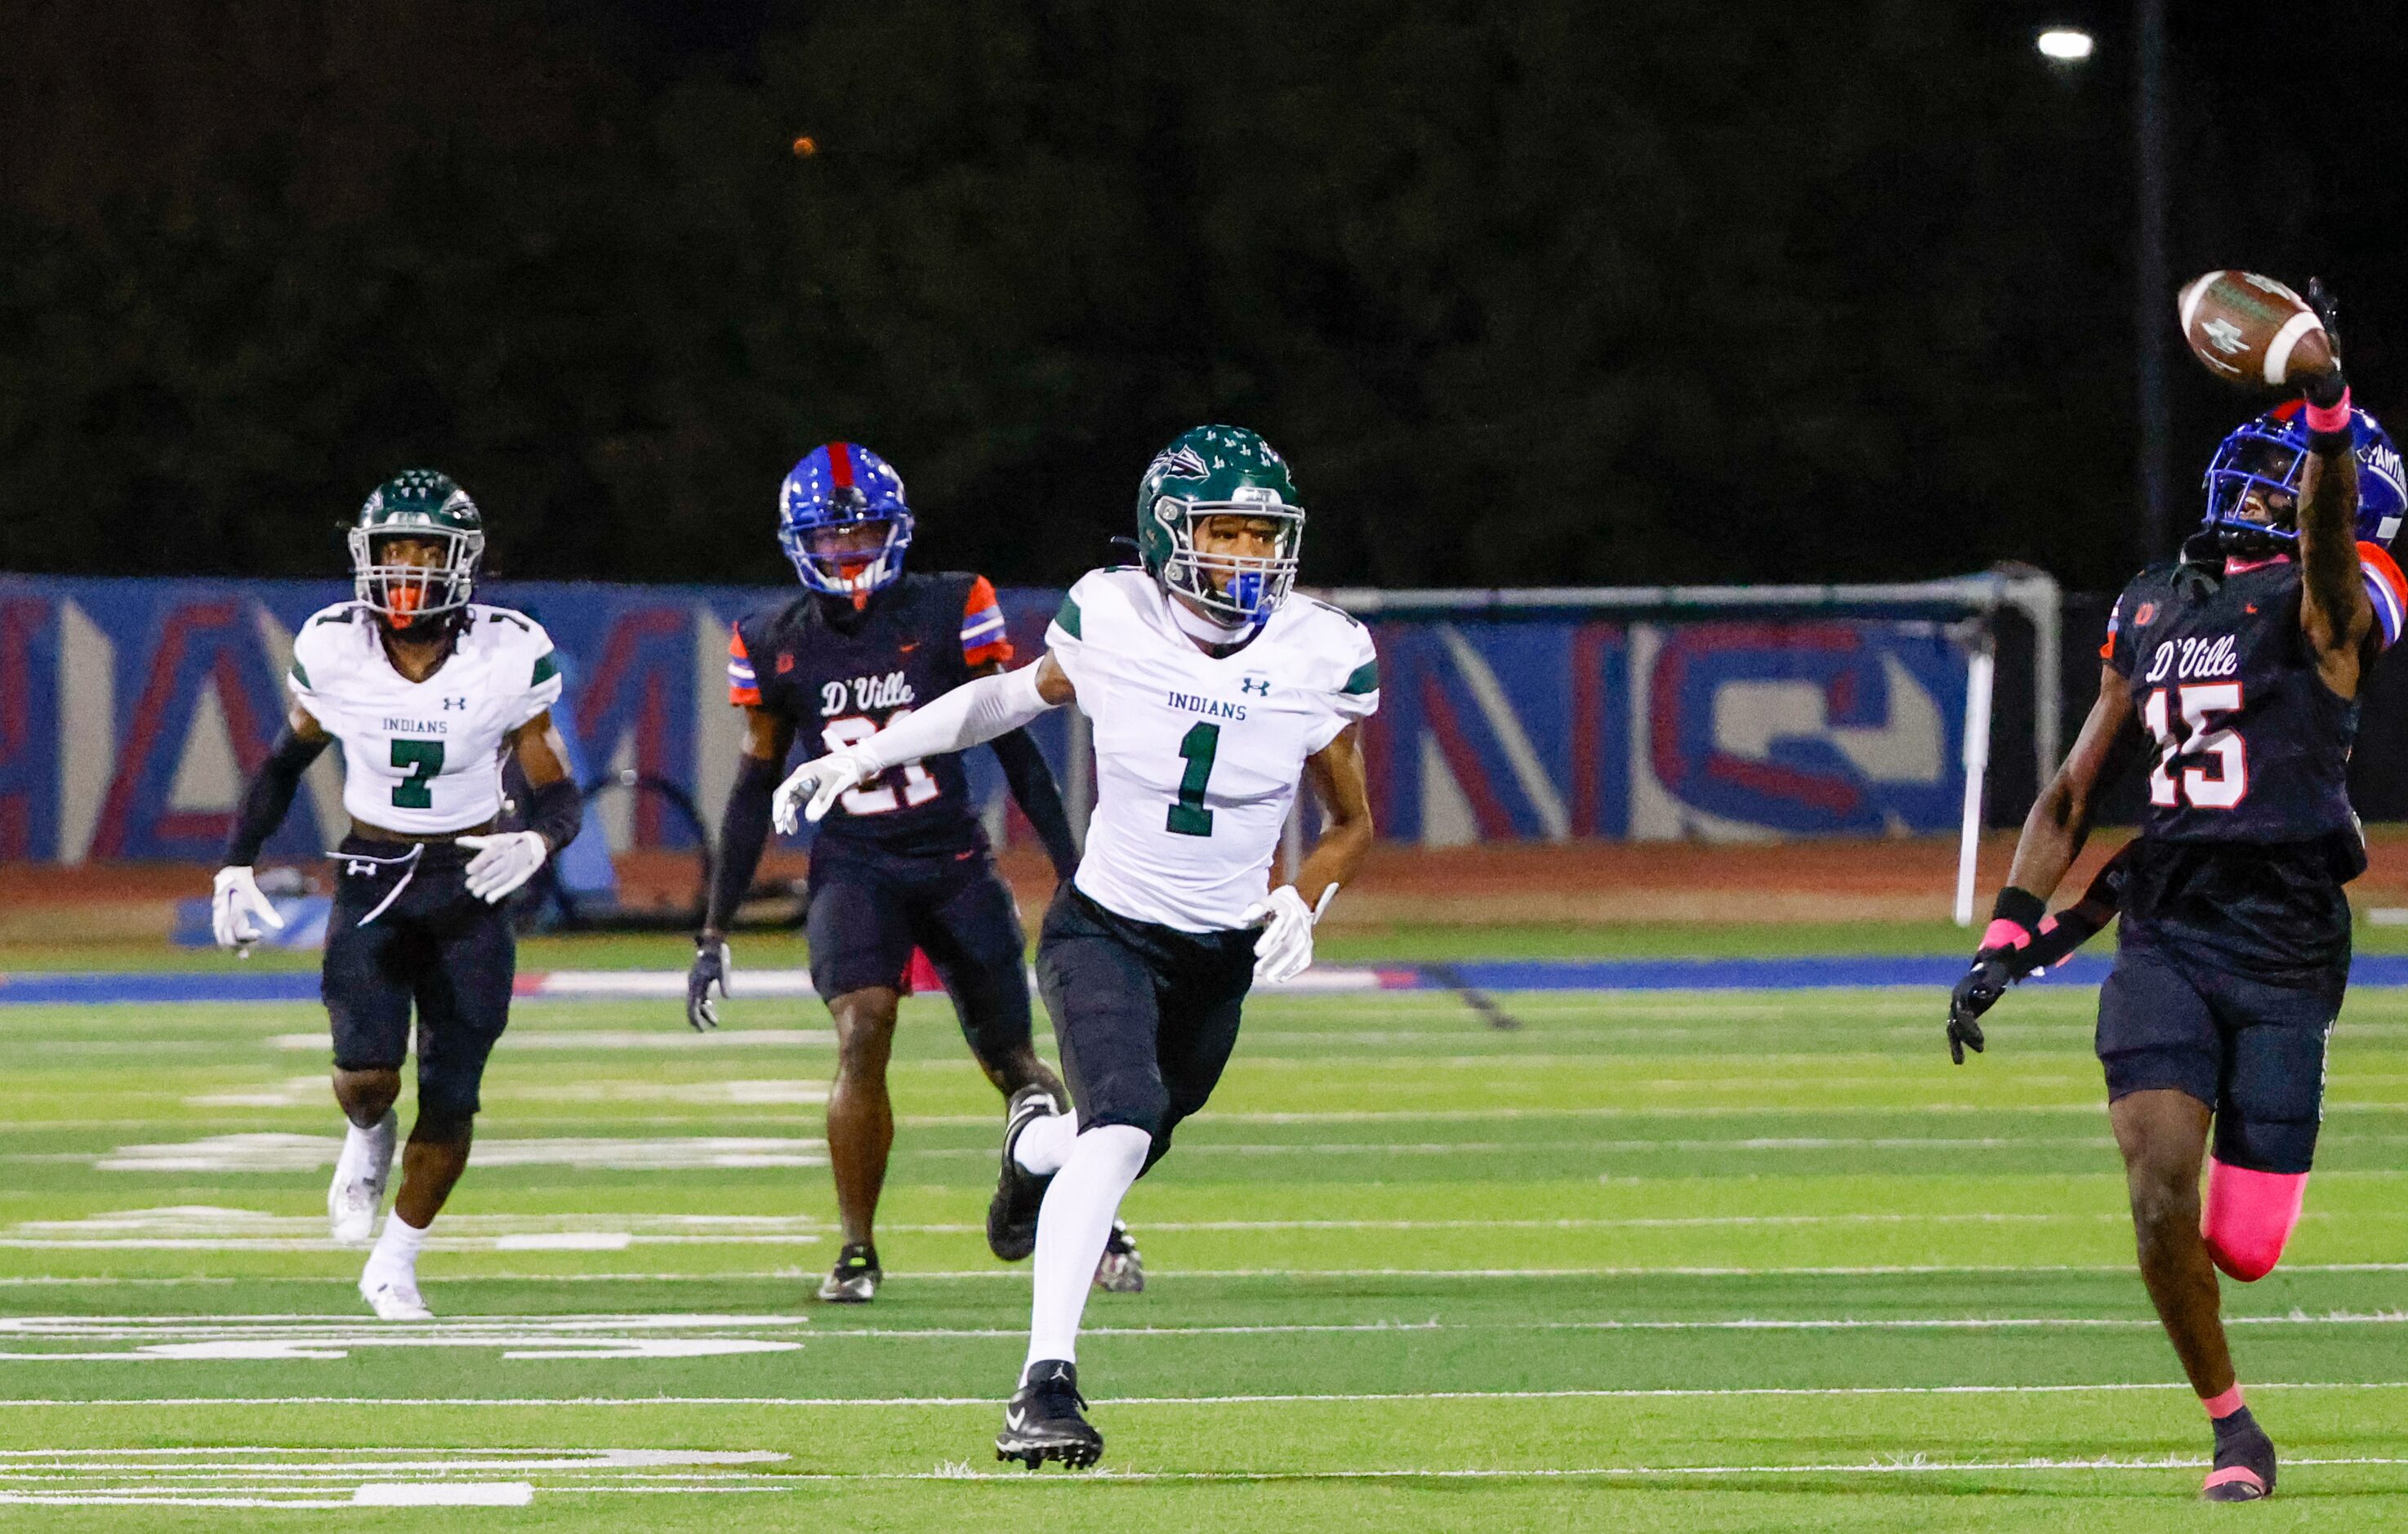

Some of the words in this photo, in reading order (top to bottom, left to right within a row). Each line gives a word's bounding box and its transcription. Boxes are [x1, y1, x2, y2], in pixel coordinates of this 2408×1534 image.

[2145, 634, 2239, 681] D'Ville
[820, 670, 916, 717] D'Ville
[1168, 690, 1247, 721] INDIANS
[382, 717, 448, 734] INDIANS
[2144, 681, 2249, 809] 15
[390, 738, 445, 809] 7
[1166, 720, 1221, 837] 1
